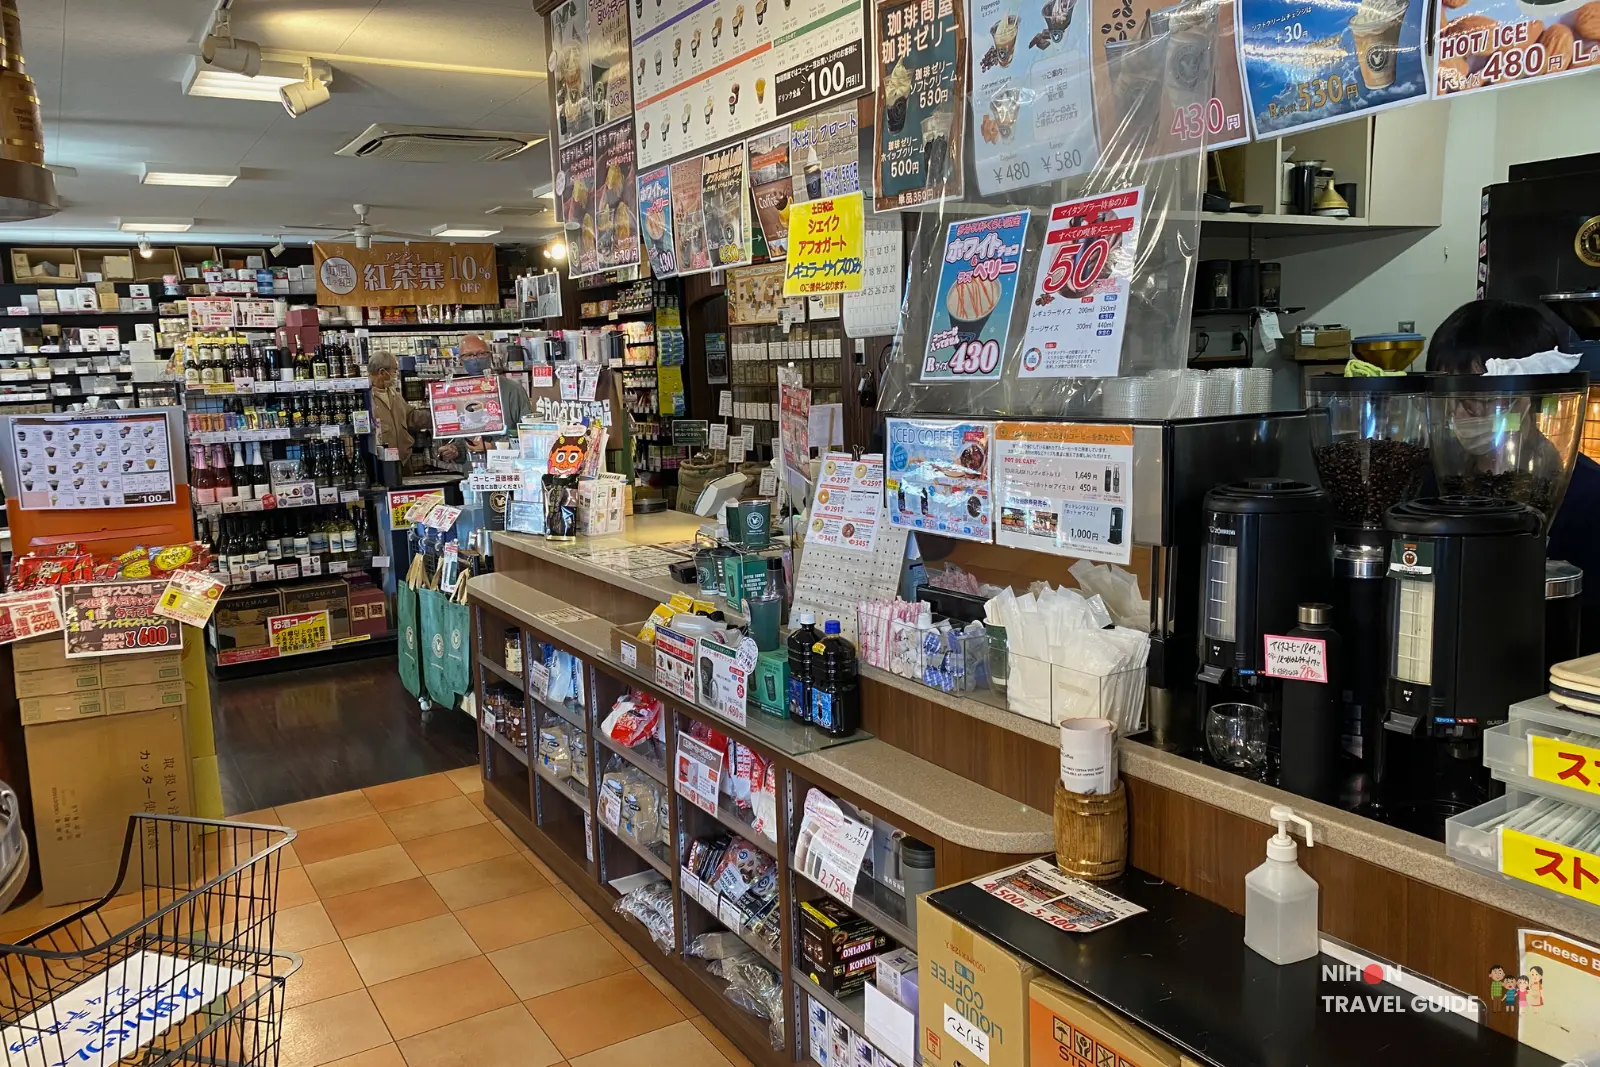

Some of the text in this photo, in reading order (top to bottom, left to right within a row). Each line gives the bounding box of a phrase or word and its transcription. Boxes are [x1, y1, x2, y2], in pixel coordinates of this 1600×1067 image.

[882, 21, 960, 64] 珈琲ゼリー
[1494, 22, 1528, 46] ICE
[914, 61, 953, 80] 珈琲ゼリー
[807, 61, 845, 100] 100
[910, 70, 957, 95] ソフトクリーム
[919, 88, 949, 108] 530円
[888, 136, 918, 151] 珈琲ゼリー
[890, 159, 920, 178] 500円
[811, 200, 834, 215] 土日祝は
[363, 256, 491, 291] 紅茶葉 10%
[787, 256, 862, 280] レギュラーサイズのみ
[1042, 239, 1110, 294] 50
[460, 283, 481, 294] OFF
[1032, 307, 1072, 318] レギュラーサイズ
[1029, 324, 1060, 333] ラージサイズ
[949, 340, 999, 374] 430
[893, 426, 959, 447] ICED COFFEE
[142, 494, 162, 503] 100
[1071, 528, 1099, 540] 1,000円
[273, 616, 325, 630] お酒コーナー
[845, 833, 865, 847] タンブラー
[857, 827, 869, 840] 1/1
[842, 941, 872, 959] KOPIKO
[1531, 939, 1588, 966] Cheese
[849, 955, 877, 971] KOPIKO
[931, 959, 984, 1009] COFFEE
[947, 1015, 985, 1053] キリマン
